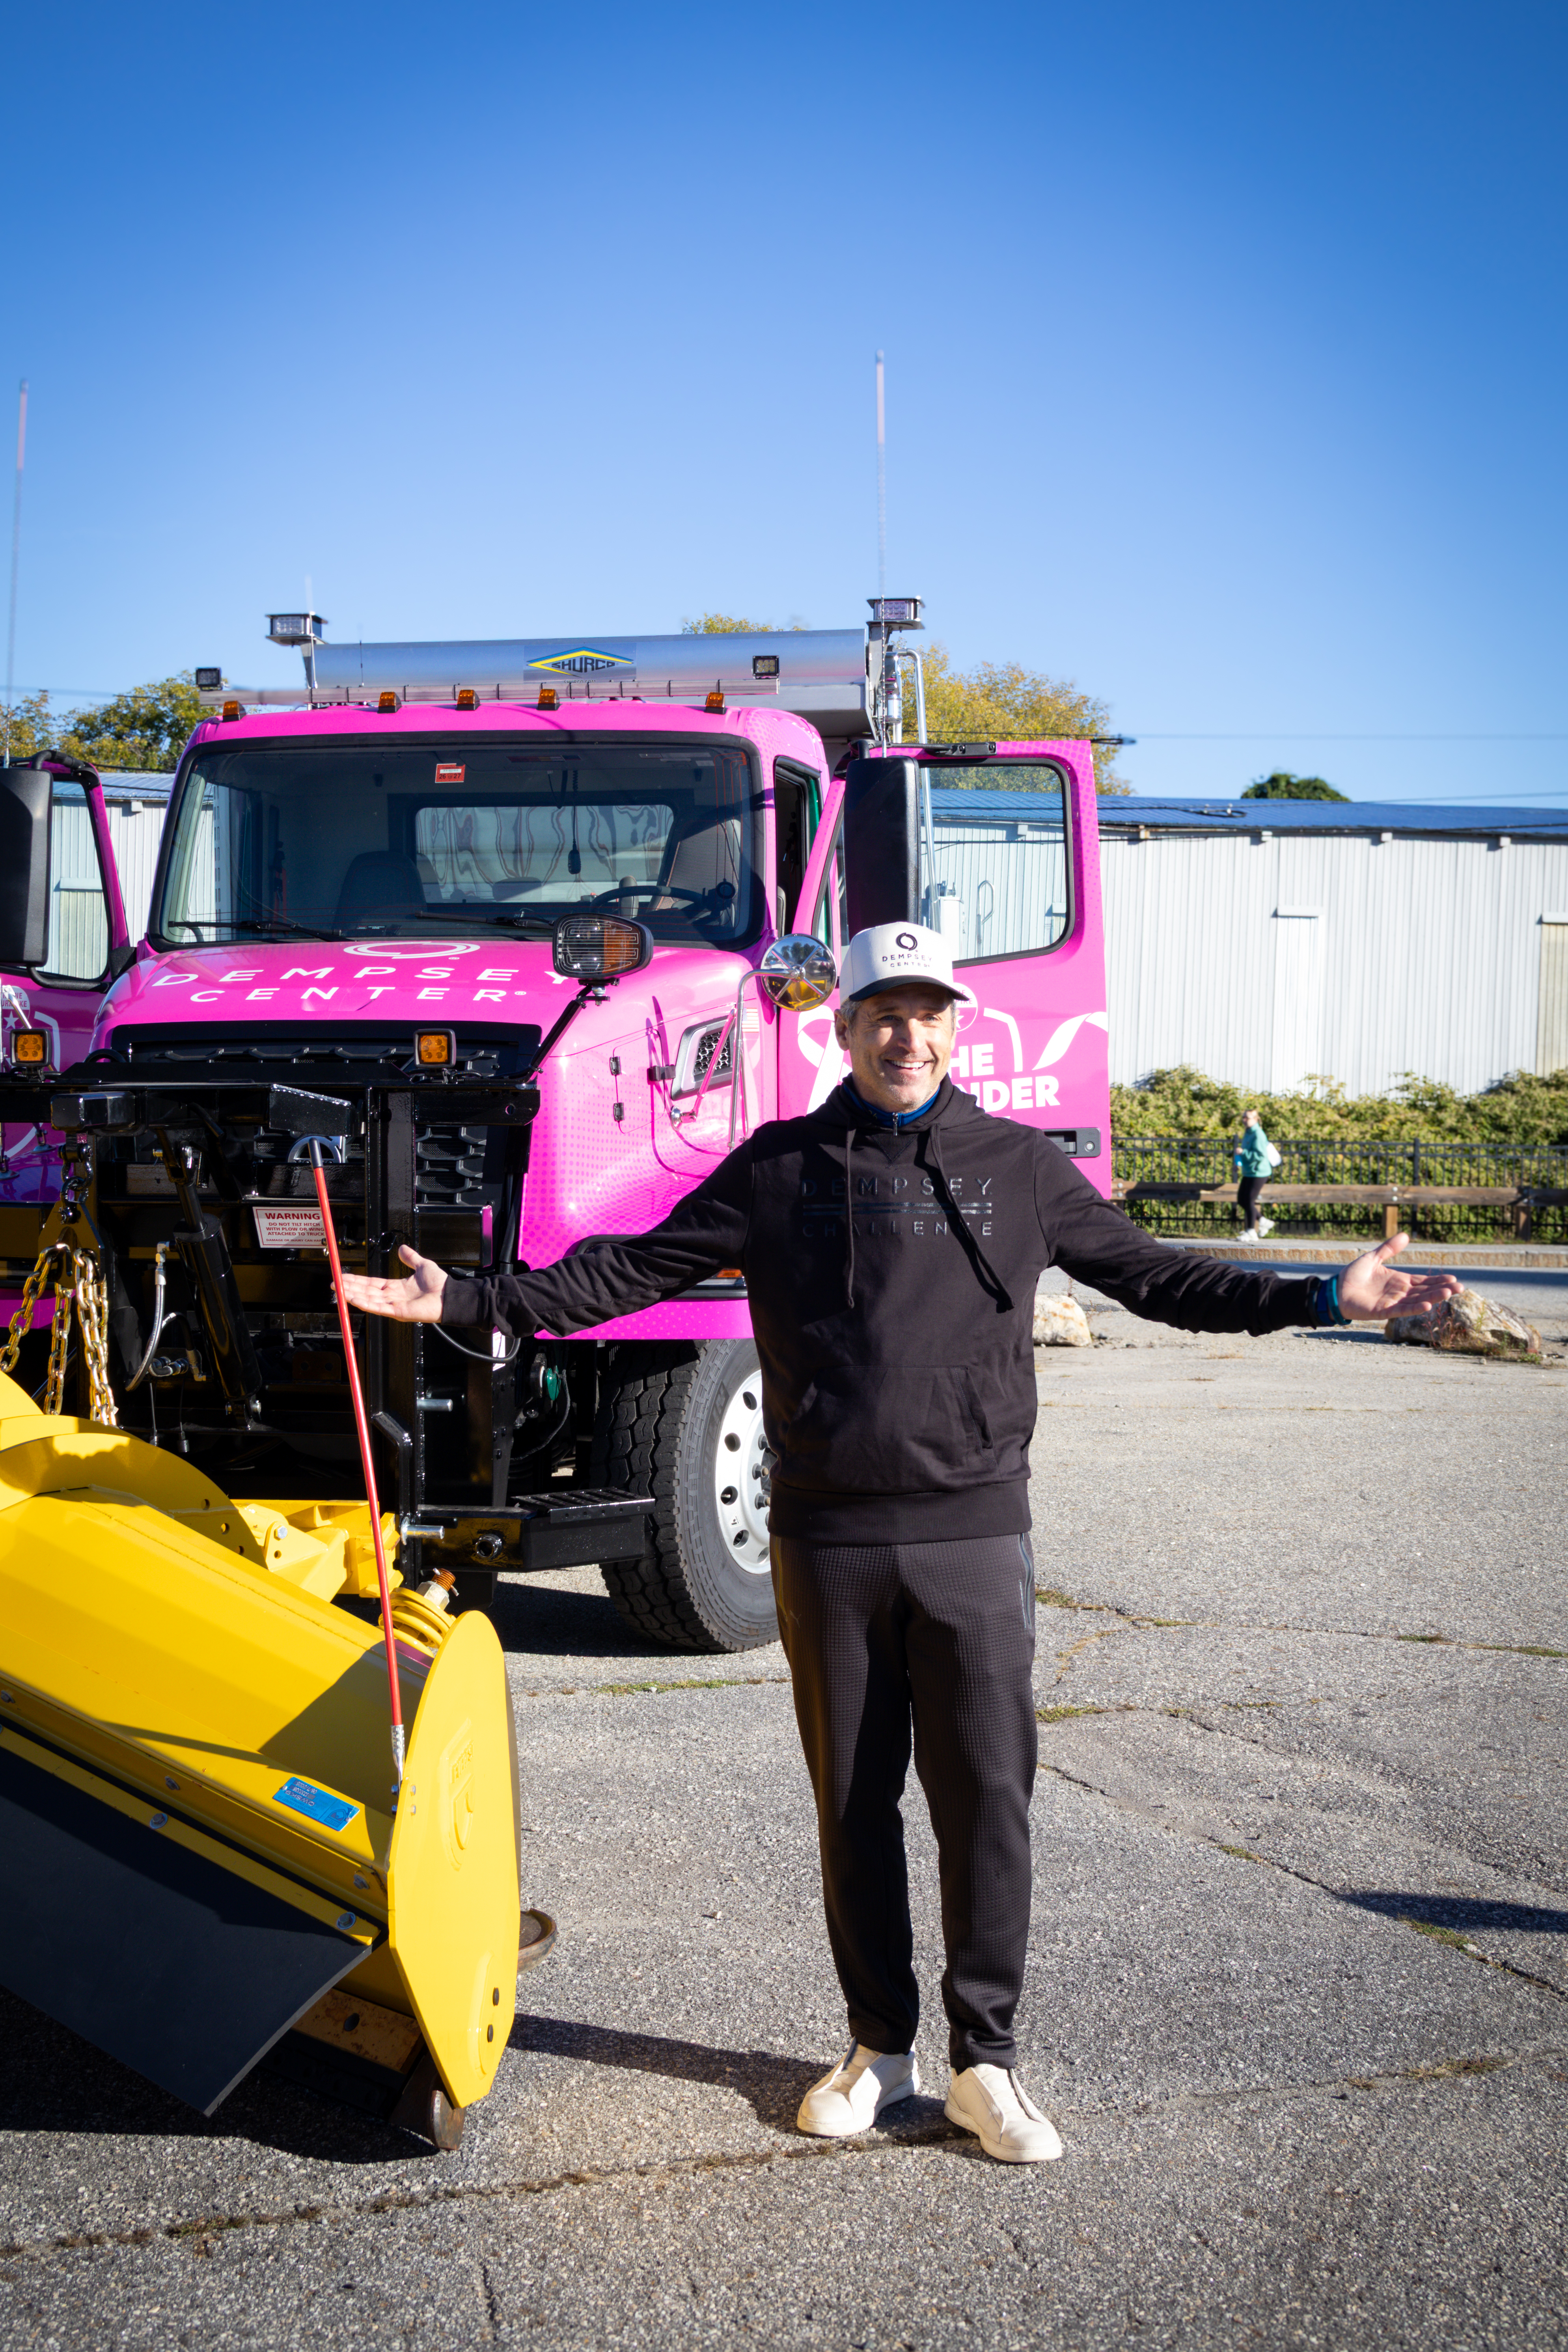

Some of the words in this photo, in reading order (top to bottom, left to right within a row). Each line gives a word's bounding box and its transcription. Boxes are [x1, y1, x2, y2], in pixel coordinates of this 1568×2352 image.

[551, 657, 615, 673] SHURCO
[882, 953, 932, 962] DEMPSEY
[151, 967, 569, 986] DEMPSEY
[950, 1044, 994, 1078] HE
[802, 1177, 991, 1196] DEMPSEY
[325, 1818, 339, 1826] EVEREST
